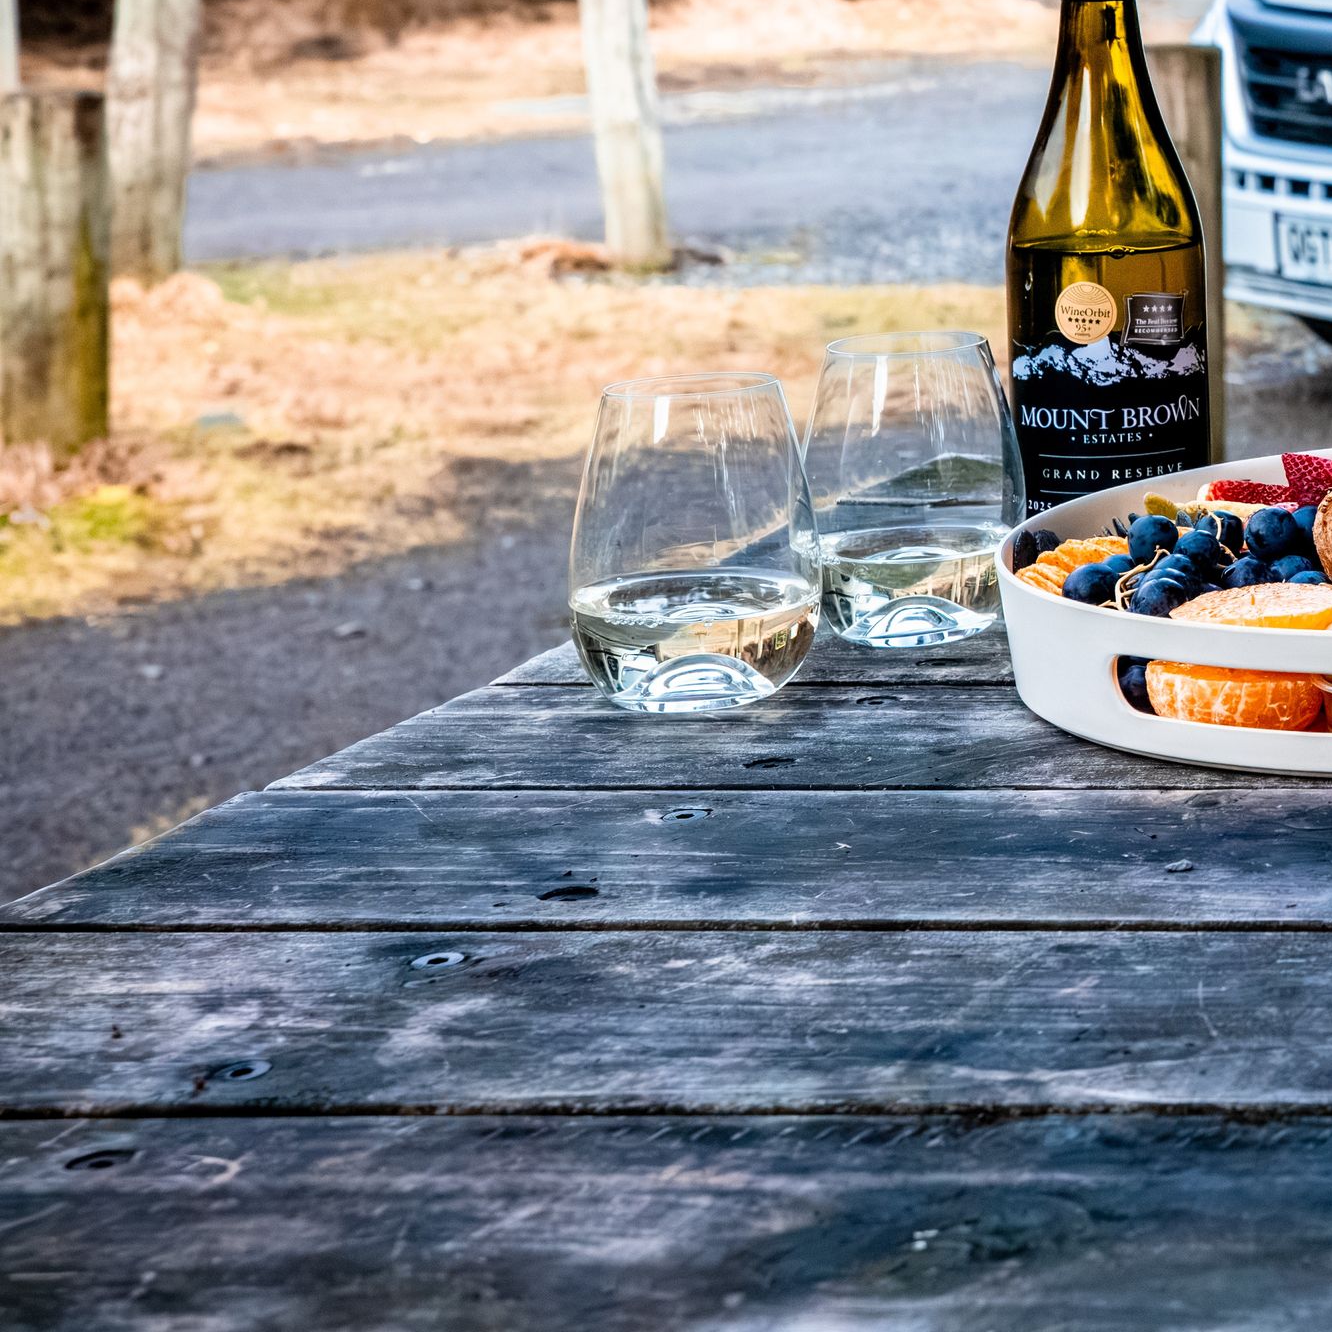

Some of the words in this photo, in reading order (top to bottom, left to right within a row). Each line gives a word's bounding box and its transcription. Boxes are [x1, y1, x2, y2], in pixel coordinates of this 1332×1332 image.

[1060, 305, 1111, 318] WineOrbit
[1021, 405, 1115, 430] MOUNT
[1121, 394, 1200, 428] BROWN
[1083, 432, 1142, 444] ESTATES
[1042, 468, 1100, 480] GRAND
[1111, 462, 1183, 480] RESERVE
